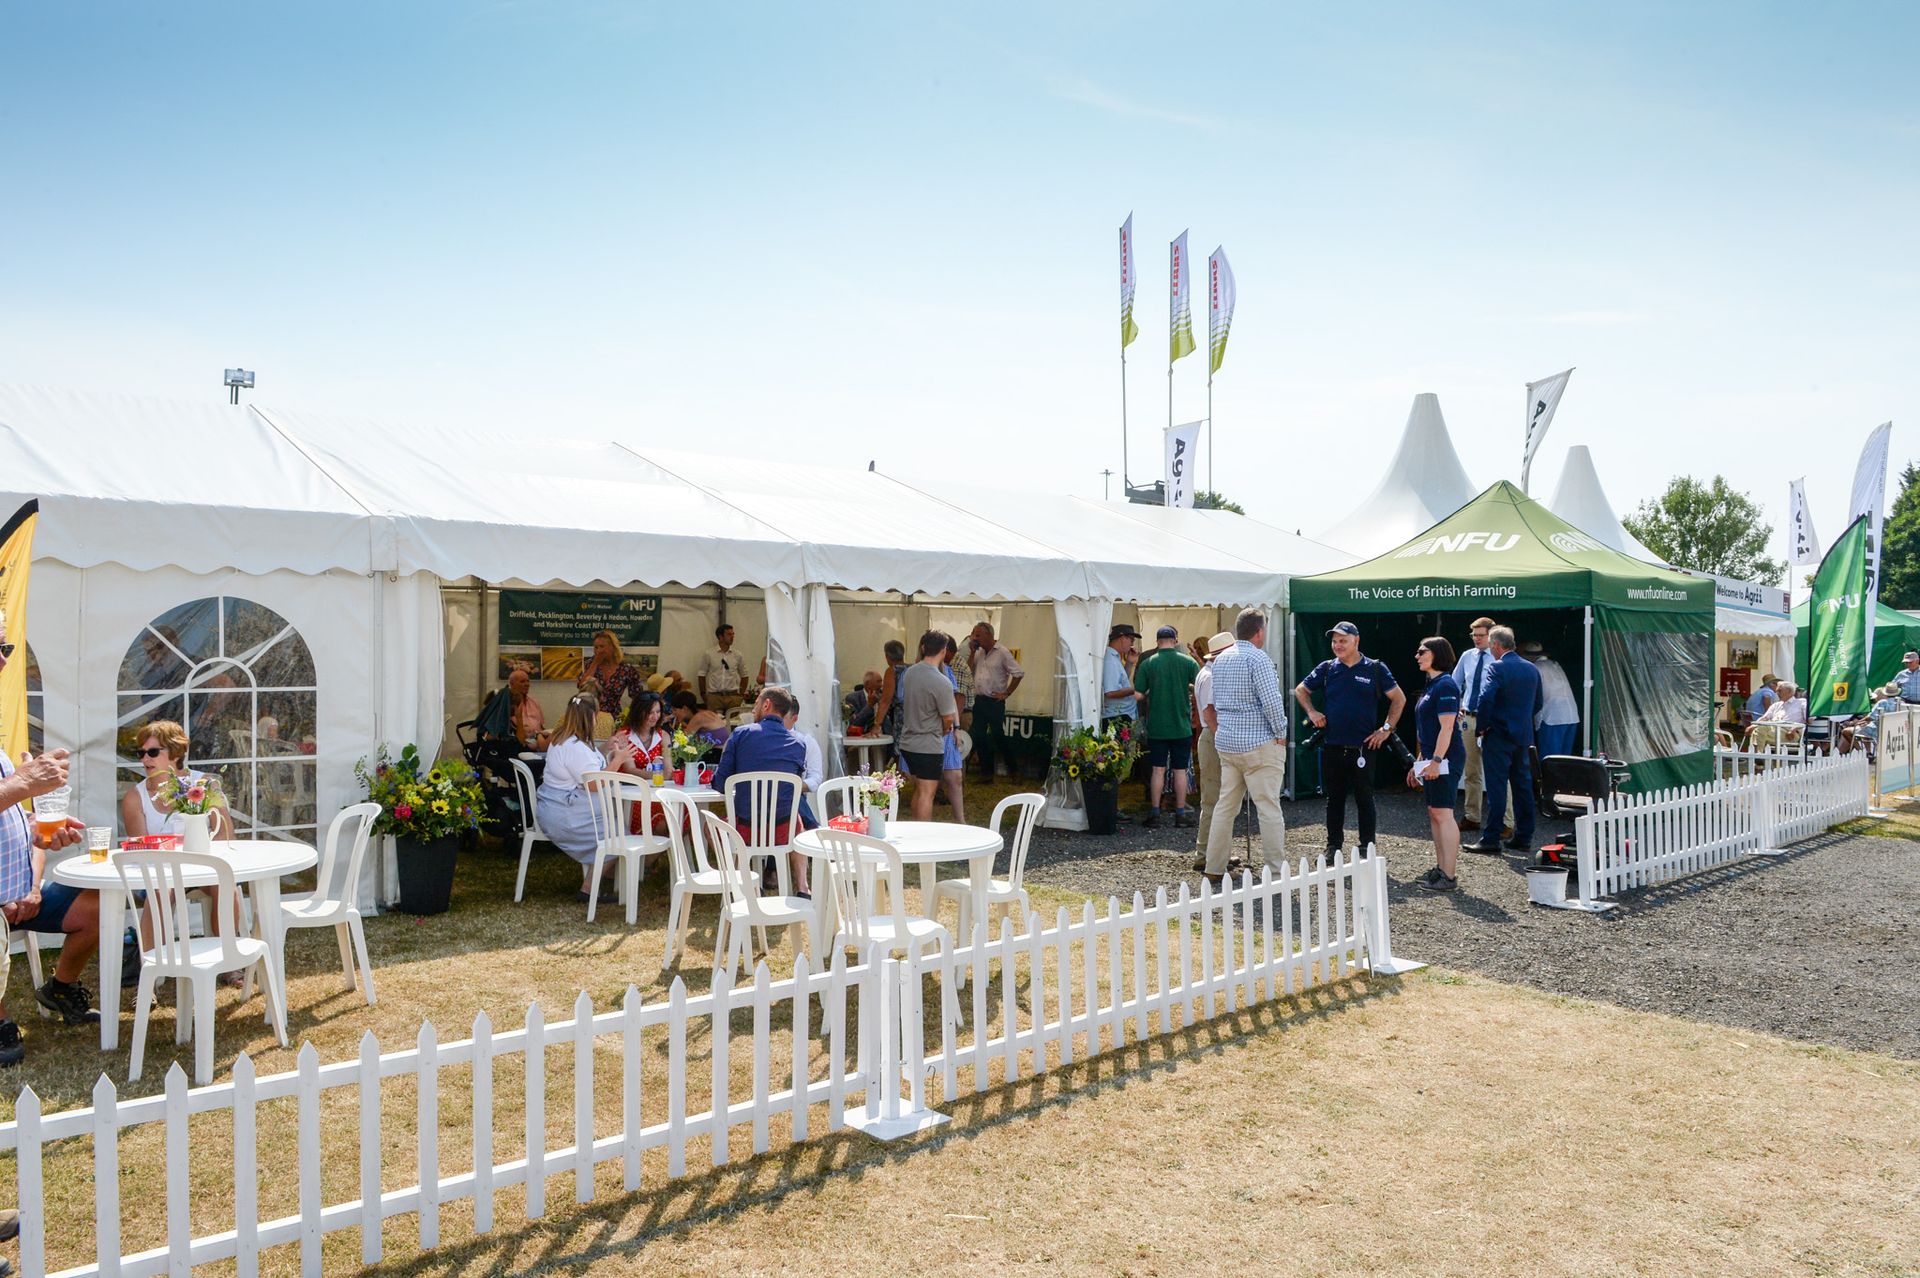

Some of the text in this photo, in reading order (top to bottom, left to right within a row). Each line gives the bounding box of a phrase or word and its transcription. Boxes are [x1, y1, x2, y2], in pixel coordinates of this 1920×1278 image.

[1426, 532, 1522, 555] NFU
[1348, 584, 1516, 600] The Voice of British Farming
[1627, 585, 1688, 600] www.nfuonline.com
[1716, 585, 1763, 606] Welcome to Agrii
[630, 599, 656, 611] NFU
[509, 610, 537, 619] Driffield,
[538, 611, 575, 620] Pocklington,
[576, 613, 602, 621] Beverley
[1886, 726, 1905, 760] Agrii
